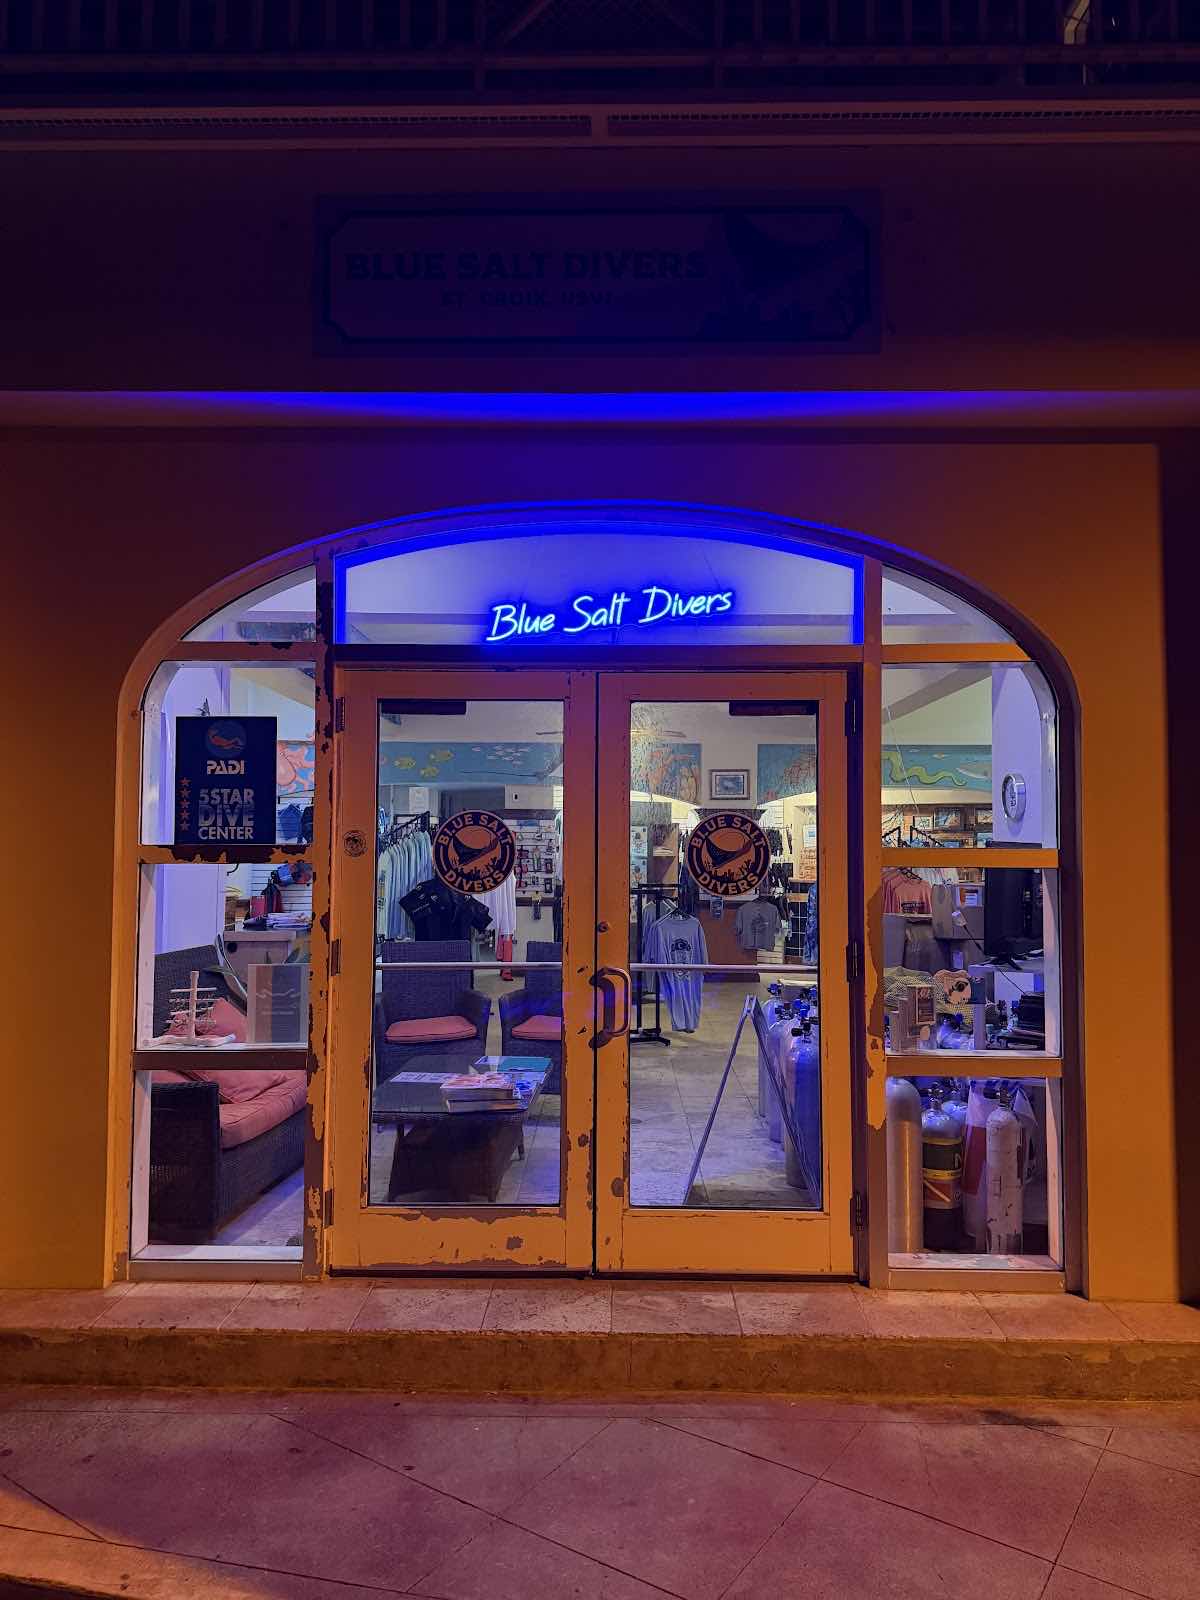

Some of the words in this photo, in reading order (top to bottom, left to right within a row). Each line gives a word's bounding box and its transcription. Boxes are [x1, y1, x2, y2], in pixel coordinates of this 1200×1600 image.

[345, 250, 447, 280] BLUE
[456, 250, 547, 280] SALT
[561, 250, 710, 280] DIVERS
[486, 603, 555, 642] Blue
[563, 592, 631, 633] Salt
[638, 585, 733, 624] Divers
[206, 760, 245, 775] PADI
[198, 826, 254, 840] CENTER
[438, 813, 474, 846] BLUE
[478, 814, 513, 846] SALT
[691, 815, 727, 848] BLUE
[731, 816, 767, 848] SALT
[444, 868, 506, 892] DIVERS
[698, 872, 760, 895] DIVERS
